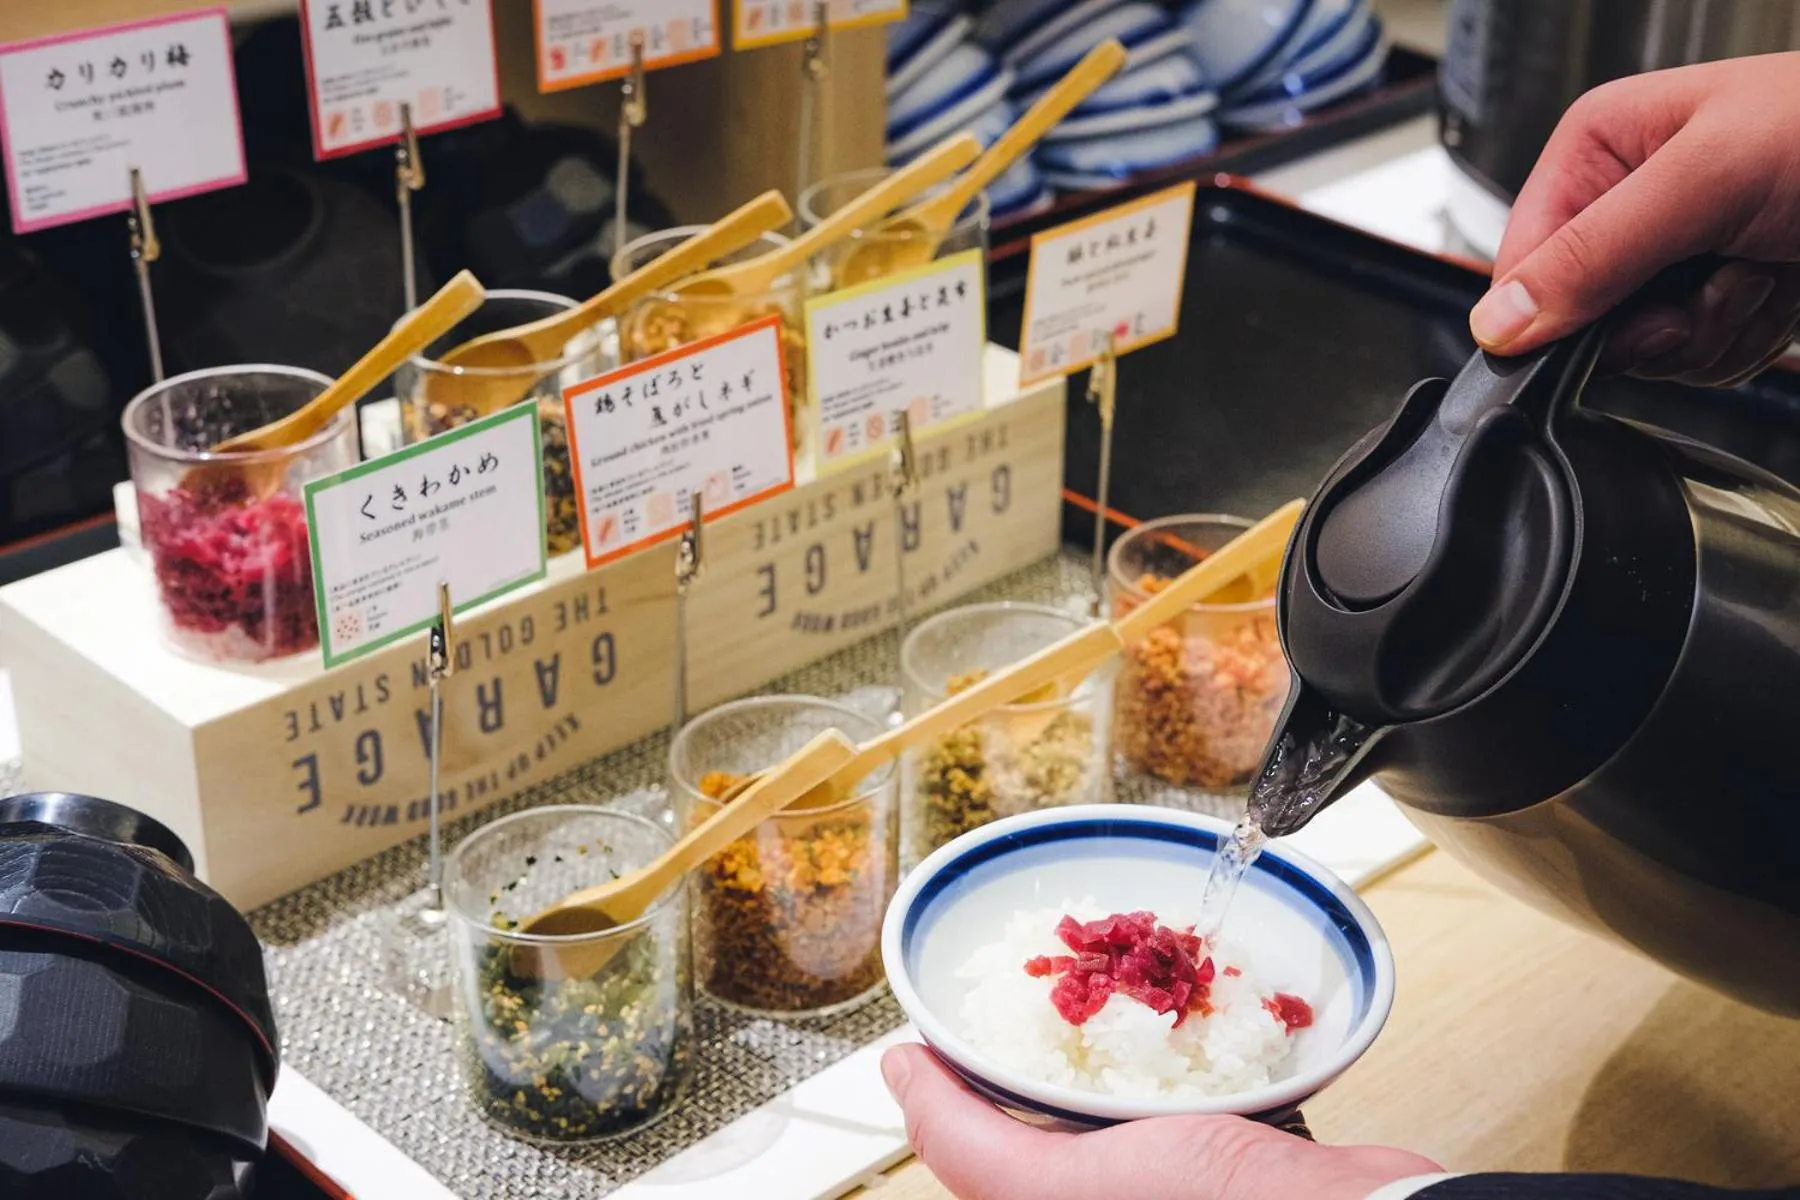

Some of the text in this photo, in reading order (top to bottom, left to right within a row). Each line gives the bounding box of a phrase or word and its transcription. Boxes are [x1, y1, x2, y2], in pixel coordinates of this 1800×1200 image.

[46, 43, 193, 92] カリカリ梅
[360, 452, 500, 521] くきわかめ
[360, 484, 498, 544] Seasoned wakame stem
[753, 492, 837, 550] STATE
[757, 462, 1011, 619] GARAGE
[553, 586, 609, 633] THE
[411, 613, 535, 688] GOLDN
[284, 673, 391, 742] STATE
[292, 631, 618, 815] GARAGE
[535, 712, 581, 762] KEEP
[465, 770, 501, 803] THE
[507, 753, 532, 781] UP
